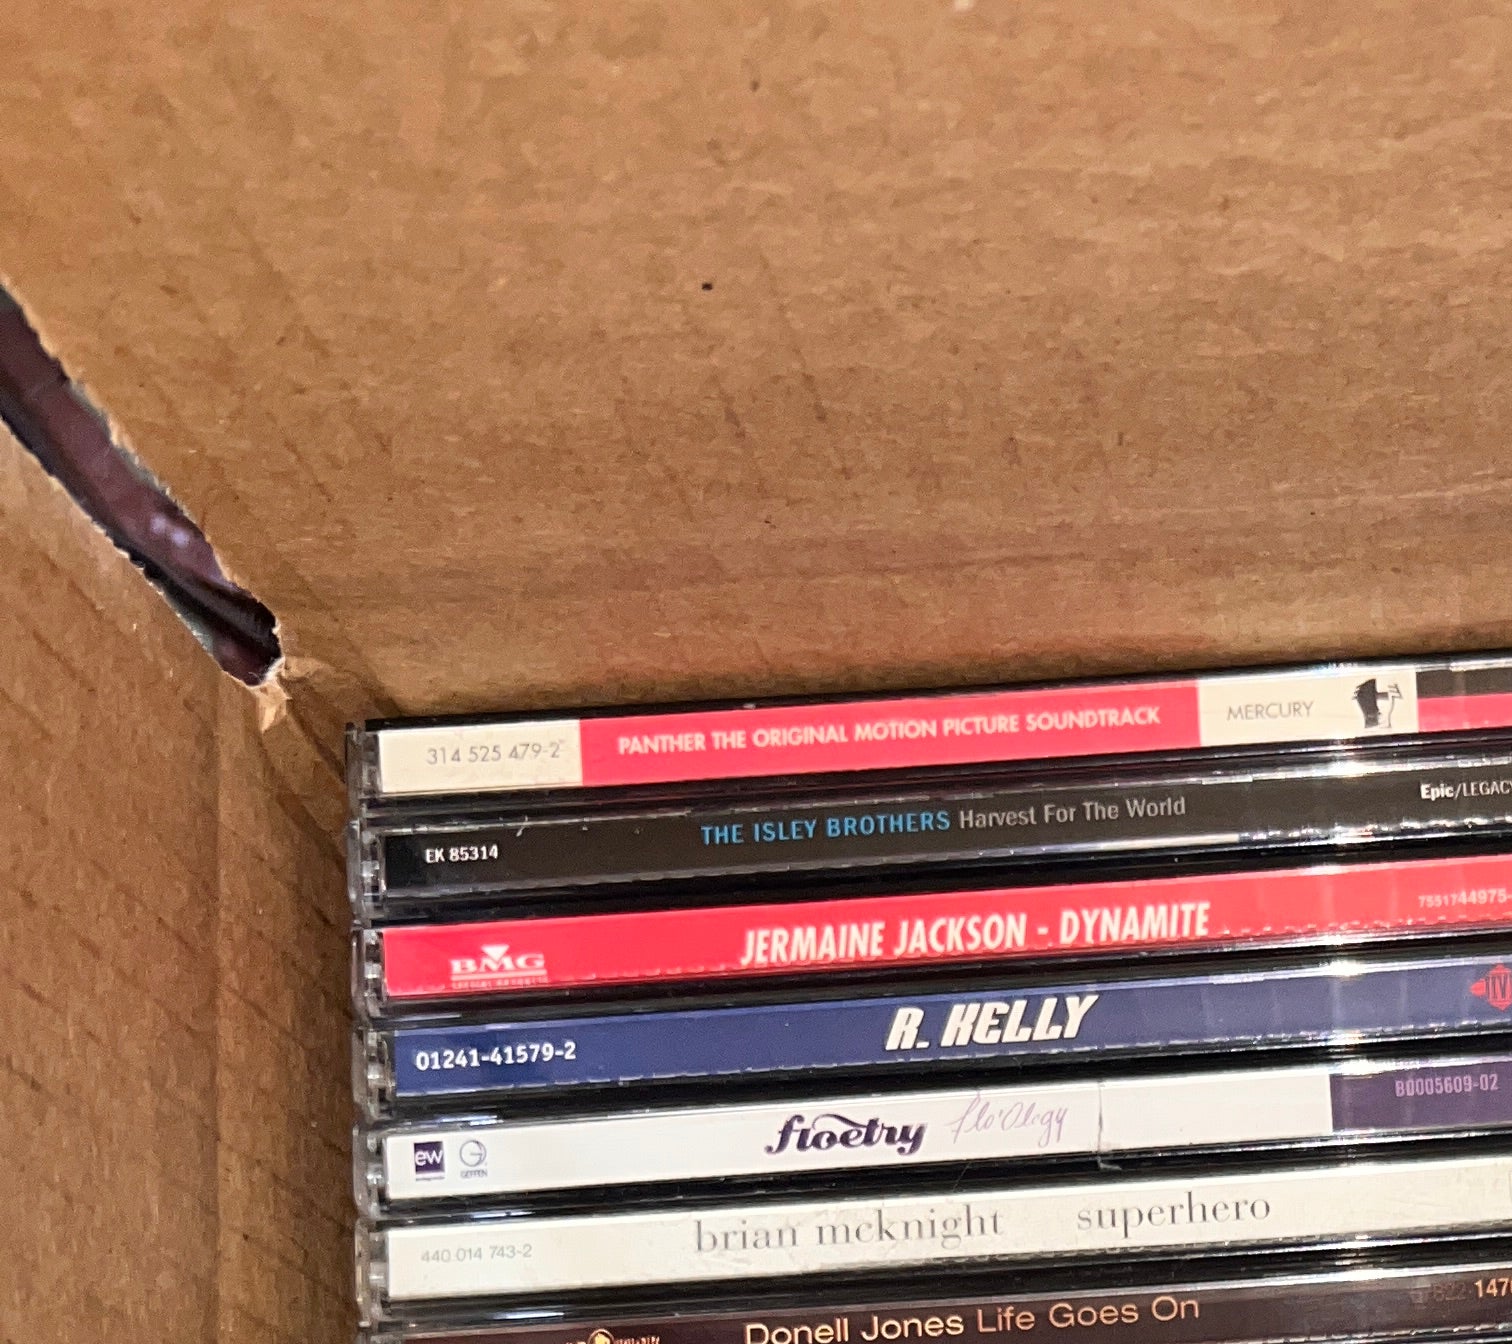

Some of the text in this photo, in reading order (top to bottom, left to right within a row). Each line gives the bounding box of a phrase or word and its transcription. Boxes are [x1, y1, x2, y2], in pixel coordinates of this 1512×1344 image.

[468, 707, 1161, 762] 525 PANTHER THE ORIGINAL MOTION PICTURE SOUNDTRACK
[450, 797, 1186, 862] 85314 THE ISLEY BROTHERS Harvest For The World
[451, 952, 545, 971] BMG
[741, 902, 1210, 966] JERMAINE JACKSON DYNAMITE
[416, 995, 1099, 1072] 01241-41579-2 R. KELLY
[694, 1192, 1271, 1253] brian mcknight superhero
[862, 1313, 964, 1341] Jones
[978, 1307, 1035, 1333] Life
[1049, 1301, 1138, 1327] Goes
[1152, 1295, 1199, 1322] On
